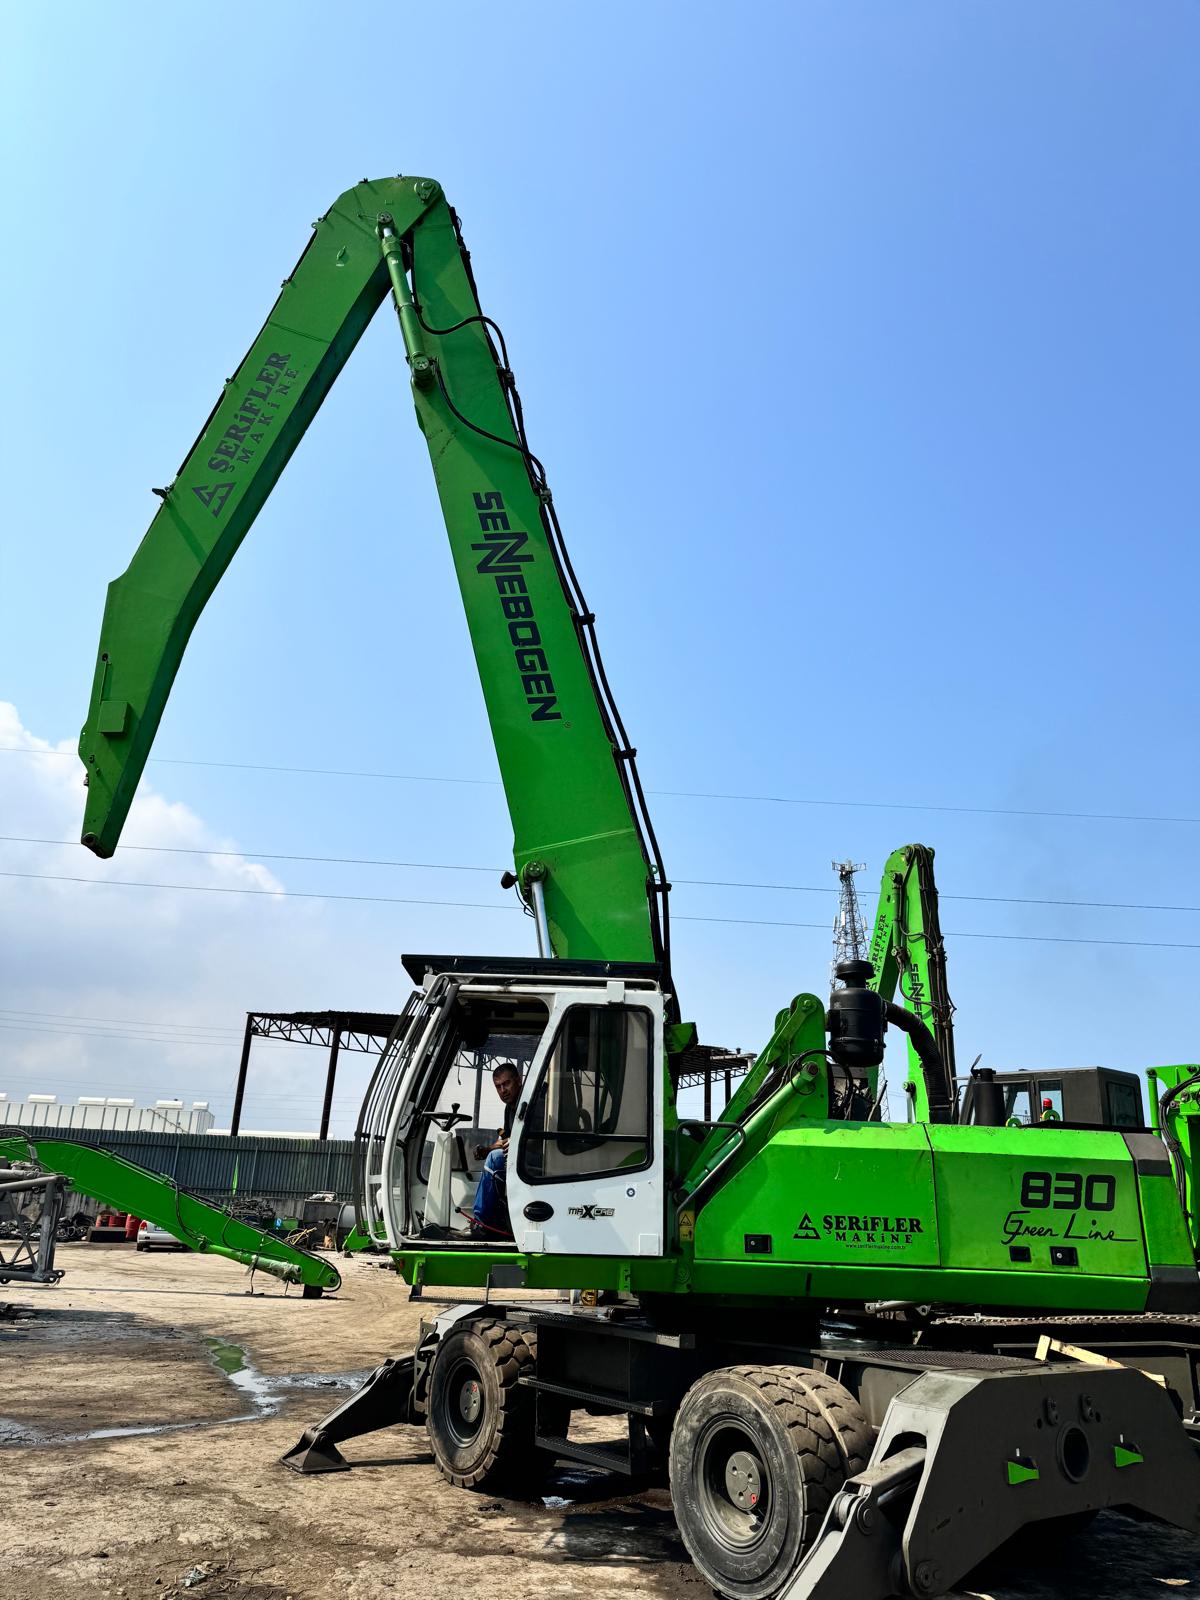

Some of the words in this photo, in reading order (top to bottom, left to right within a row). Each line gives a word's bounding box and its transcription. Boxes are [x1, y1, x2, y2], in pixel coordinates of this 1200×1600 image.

[471, 491, 563, 721] SENNEBOGEN
[1020, 1171, 1116, 1212] 830
[1001, 1210, 1059, 1245] Green
[1063, 1212, 1138, 1242] Line
